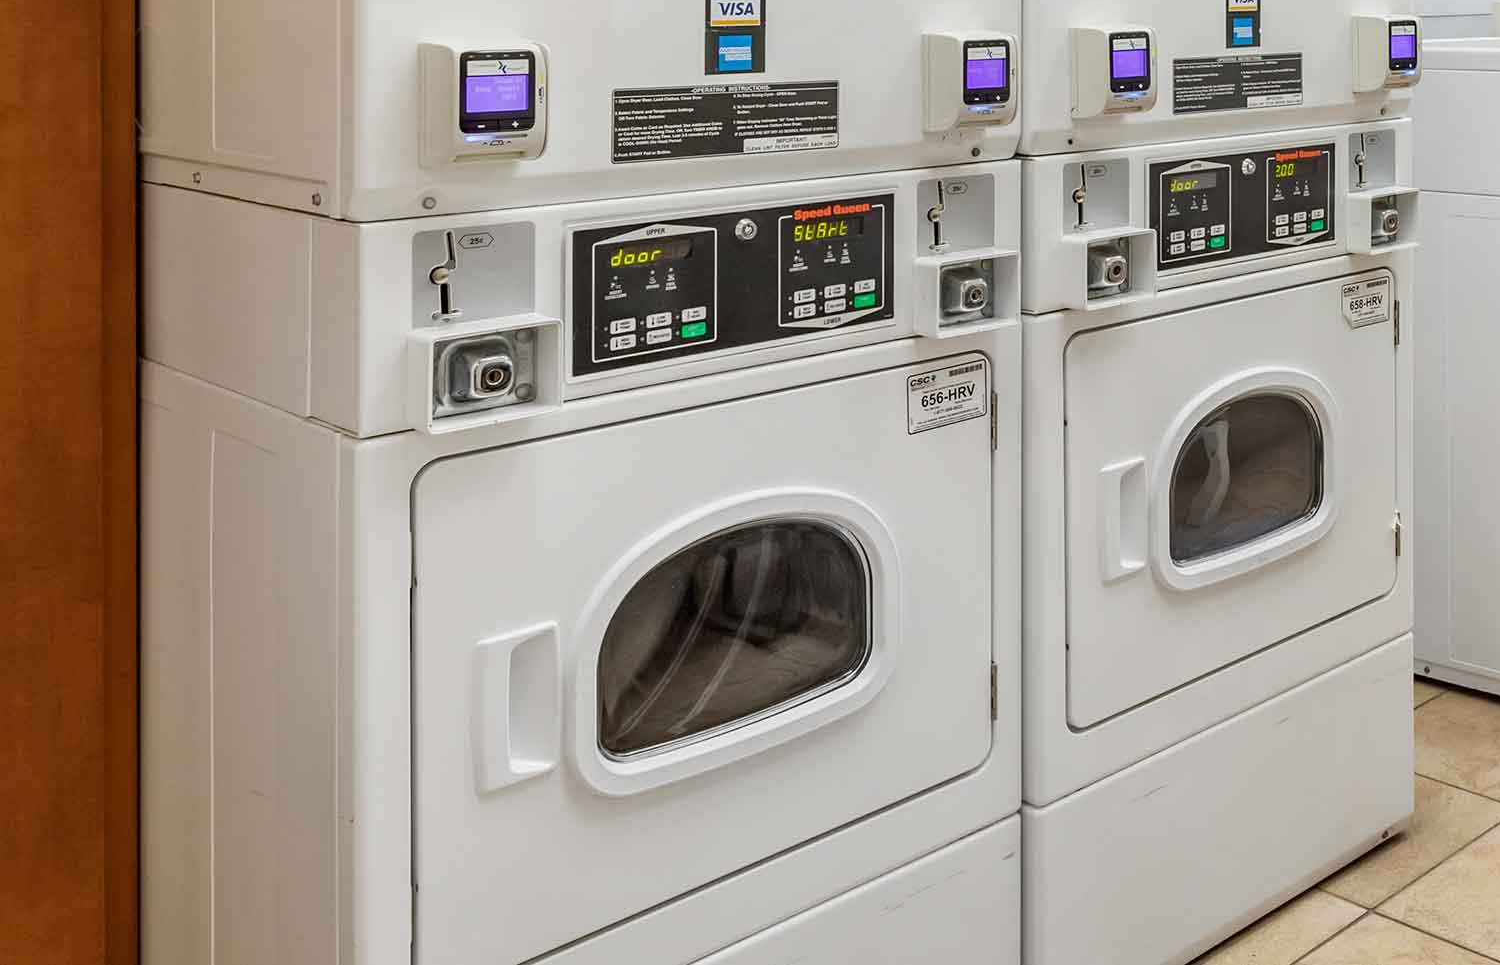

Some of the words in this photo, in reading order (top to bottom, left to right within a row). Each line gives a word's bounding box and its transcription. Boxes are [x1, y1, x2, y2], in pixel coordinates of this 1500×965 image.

[718, 3, 754, 16] VISA
[794, 206, 832, 221] Speed
[833, 203, 870, 215] Queen
[646, 227, 665, 236] UPPER
[611, 248, 662, 267] door
[1350, 295, 1383, 311] 658-HRV
[910, 376, 930, 387] CSC
[921, 383, 976, 408] 656-HRV
